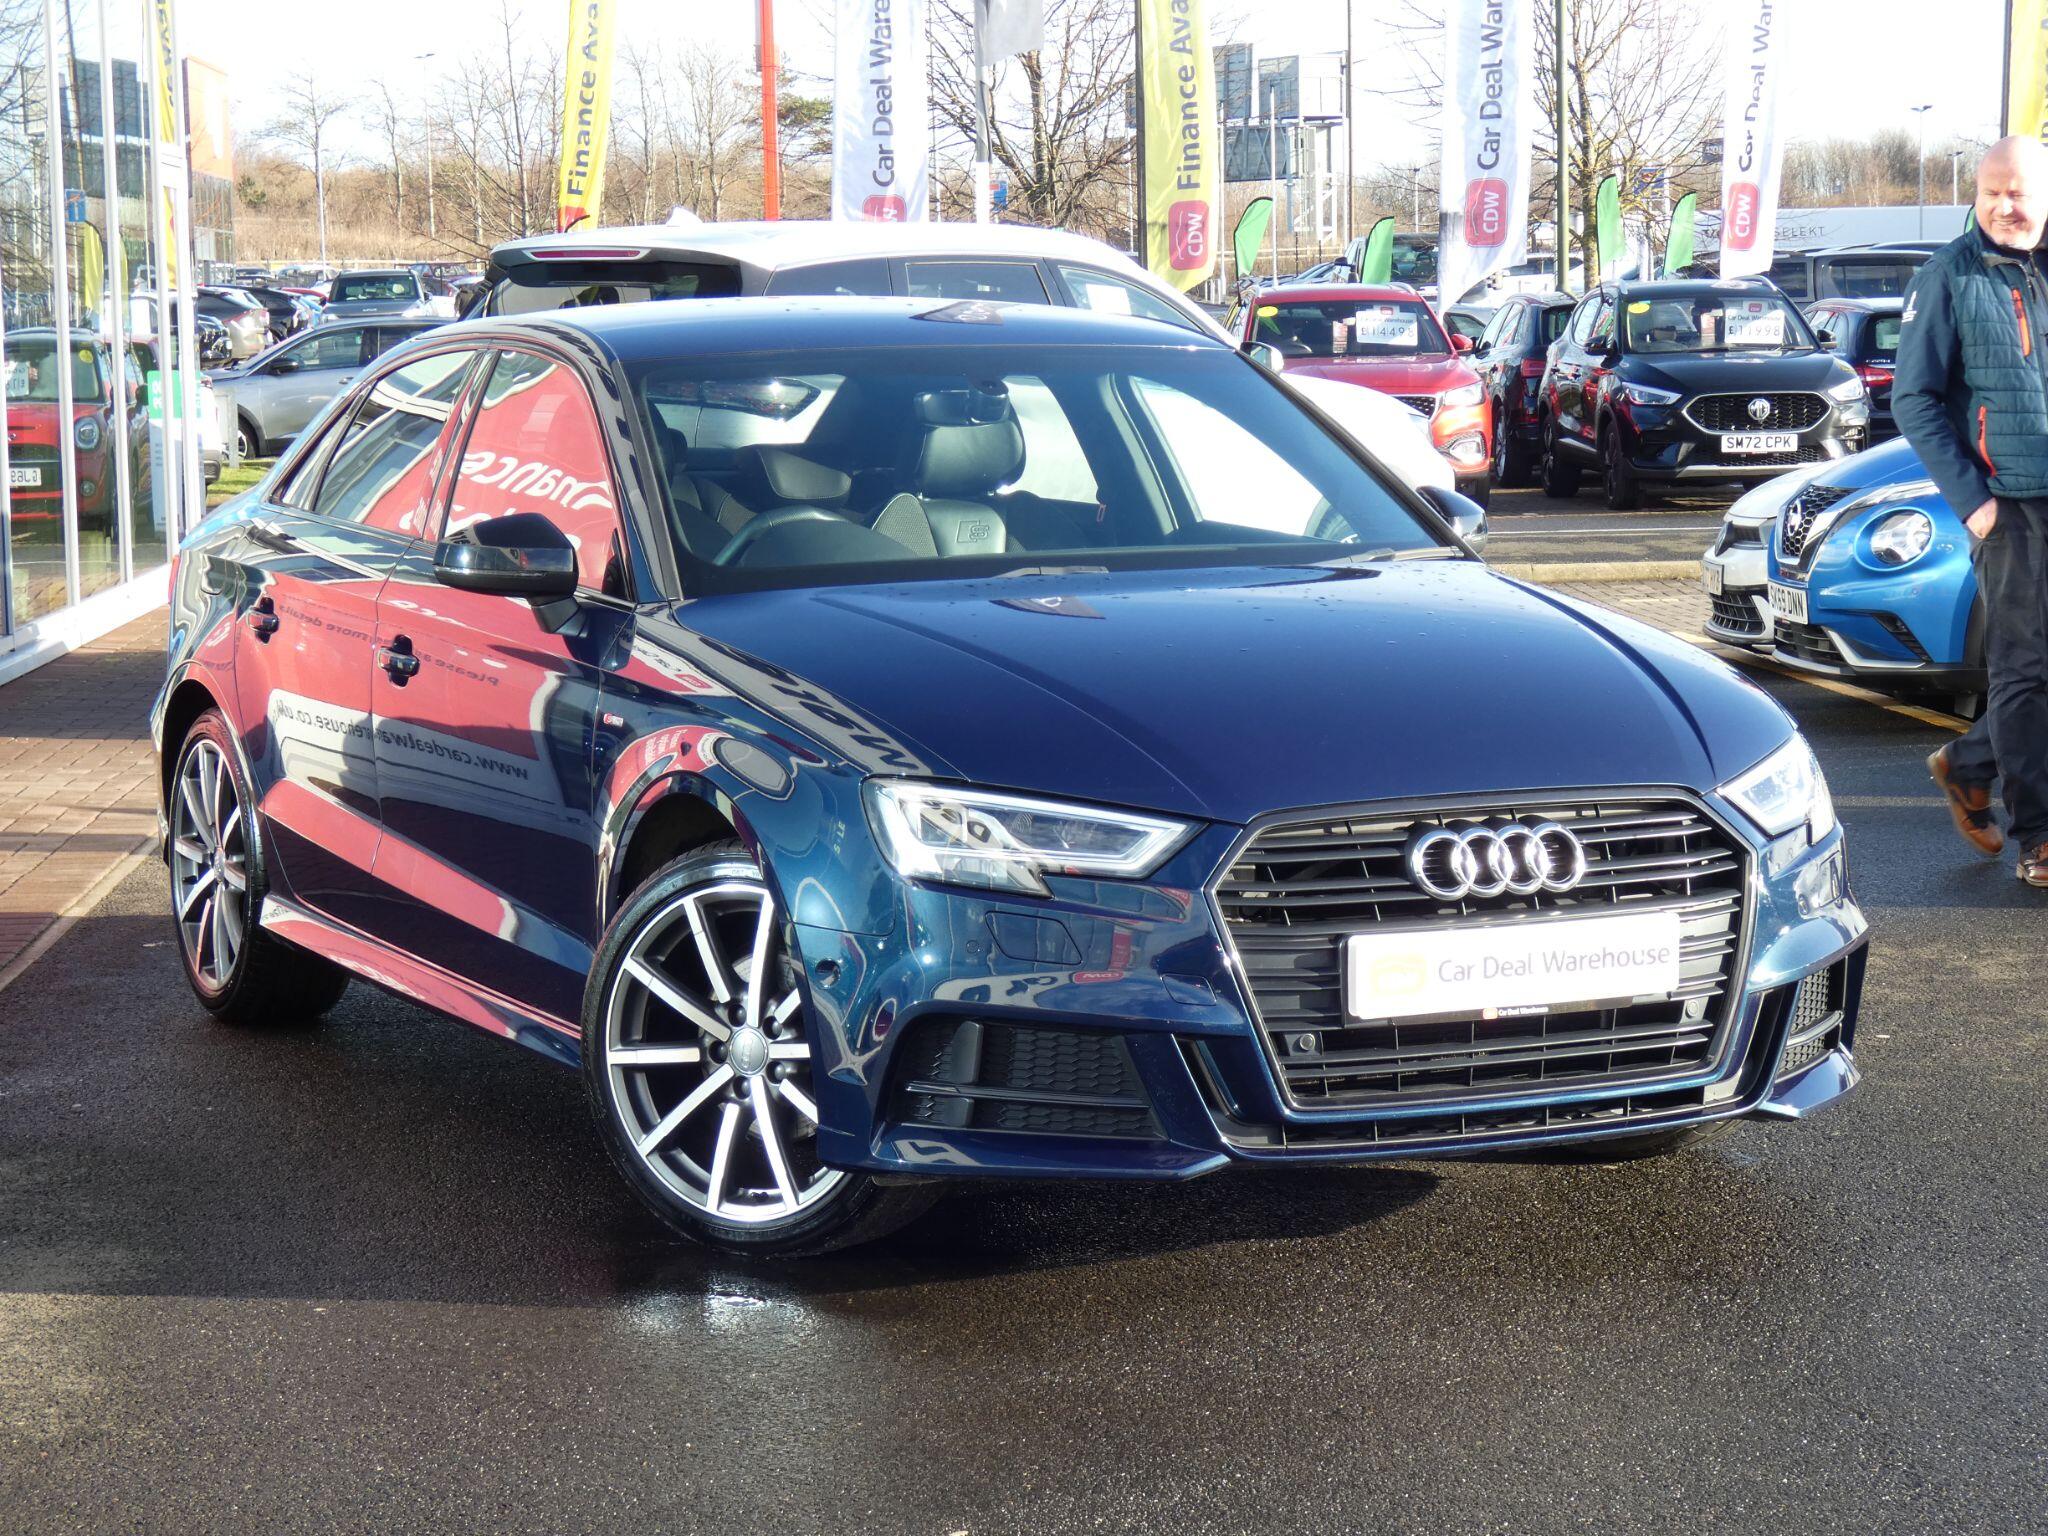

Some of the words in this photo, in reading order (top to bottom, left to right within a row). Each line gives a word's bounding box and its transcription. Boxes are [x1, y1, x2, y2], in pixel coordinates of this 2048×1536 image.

[869, 0, 892, 68] Ware
[870, 75, 894, 136] Deal
[1480, 59, 1503, 120] Deal
[567, 70, 597, 196] Finance
[1177, 64, 1200, 190] Finance
[1477, 127, 1501, 171] Car
[872, 144, 895, 187] Car
[1187, 212, 1204, 257] CDW
[1482, 190, 1500, 234] CDW
[1734, 193, 1751, 238] CDW
[1726, 436, 1762, 449] SM72
[1765, 435, 1791, 448] CPK
[1438, 960, 1473, 983] Car
[1482, 954, 1533, 980] Deal
[1541, 944, 1671, 974] Warehouse
